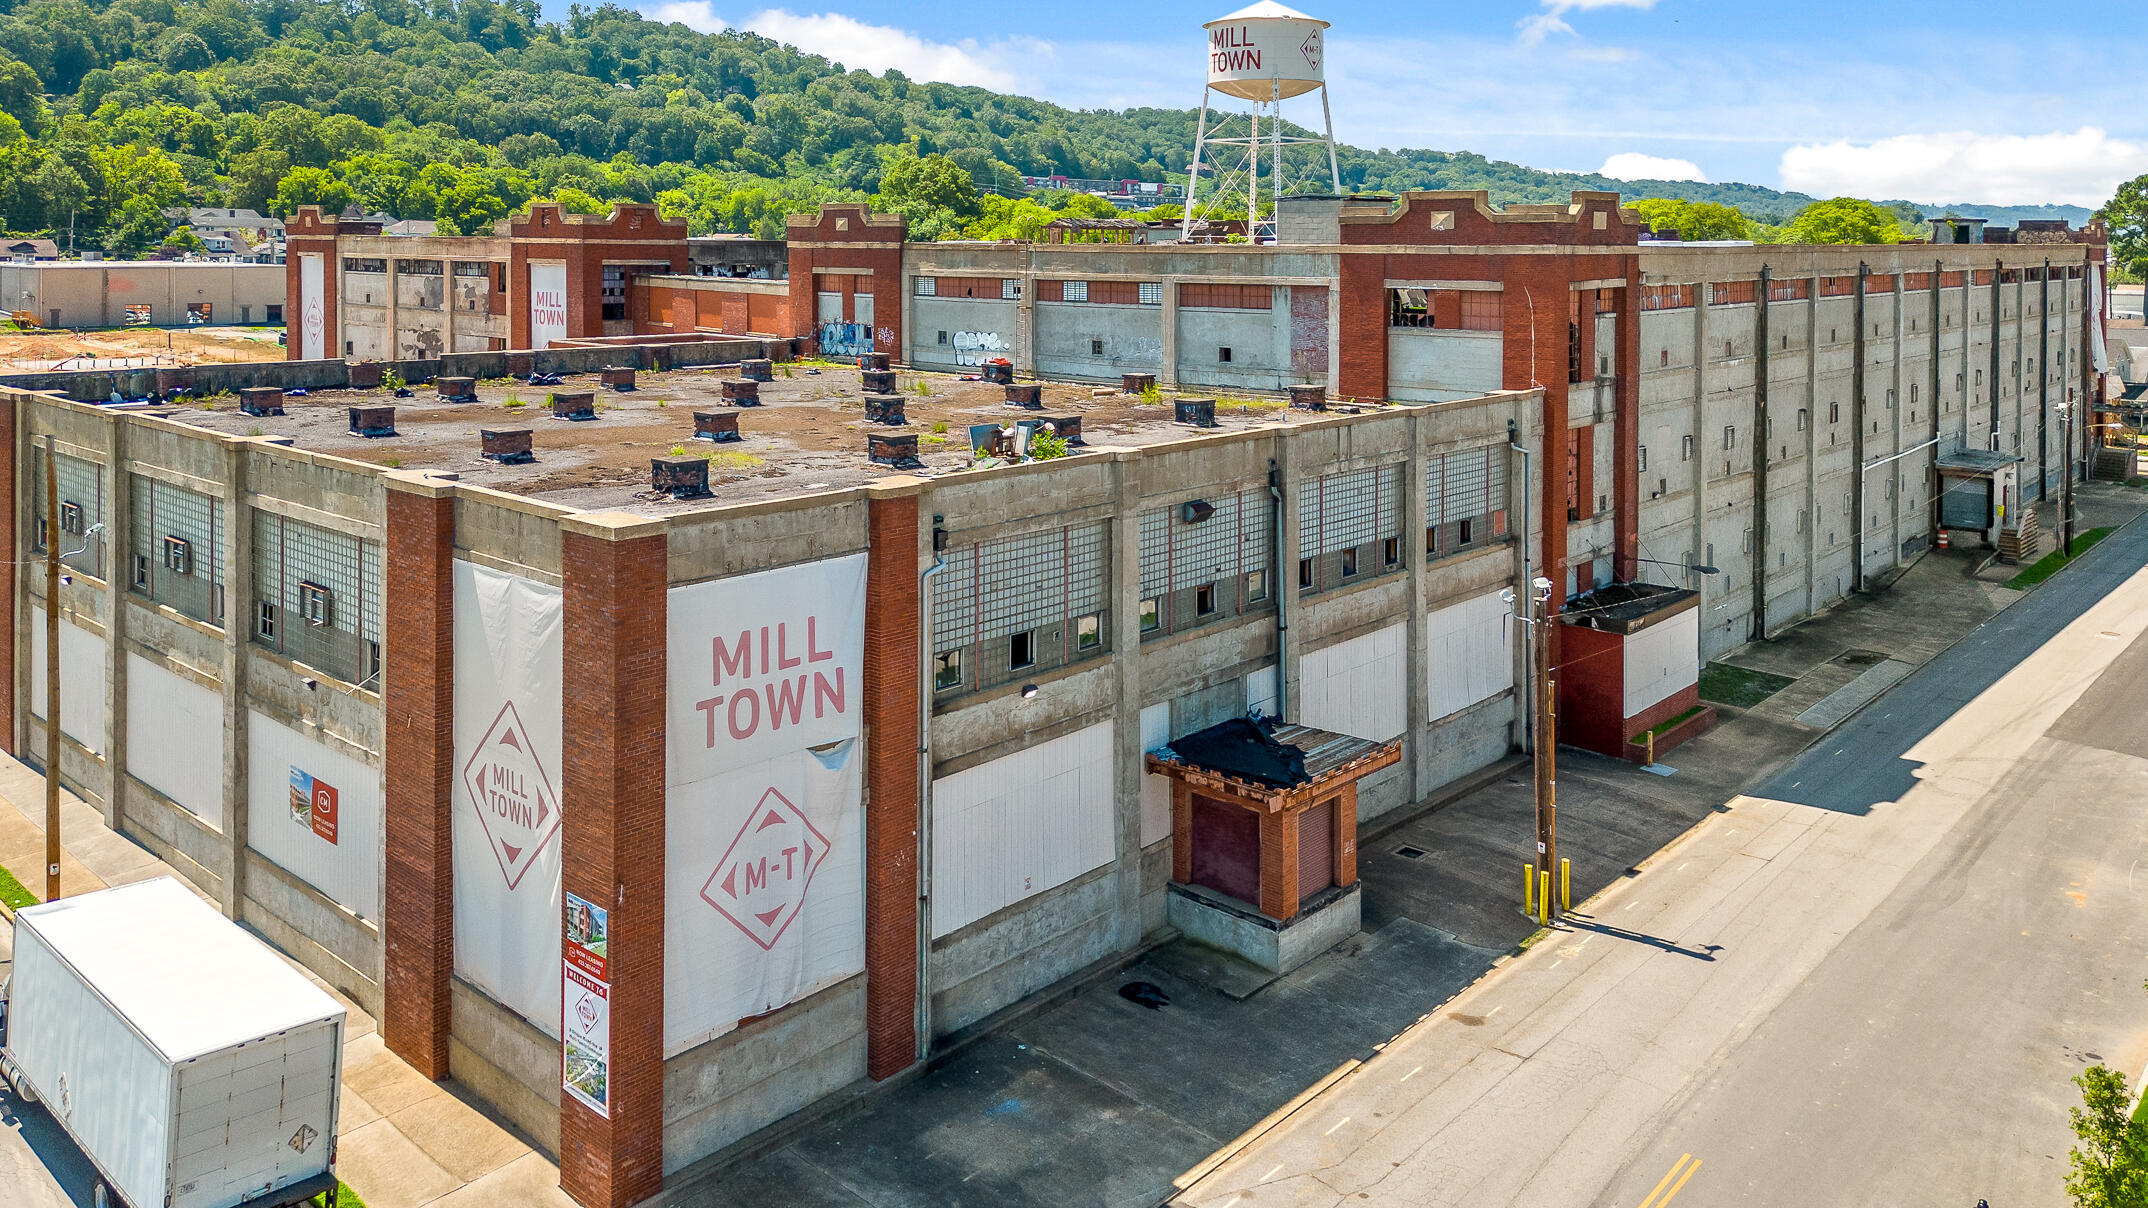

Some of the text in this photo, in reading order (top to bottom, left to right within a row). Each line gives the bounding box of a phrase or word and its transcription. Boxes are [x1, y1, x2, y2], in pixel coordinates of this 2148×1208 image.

[1214, 26, 1255, 49] MILL
[1211, 50, 1261, 73] TOWN
[537, 291, 561, 307] MILL
[534, 309, 564, 326] TOWN
[712, 616, 833, 686] MILL
[695, 667, 845, 748] TOWN
[493, 763, 528, 800] MILL
[489, 788, 532, 830] TOWN
[745, 847, 798, 895] M-T
[569, 970, 604, 996] WELCOME TO
